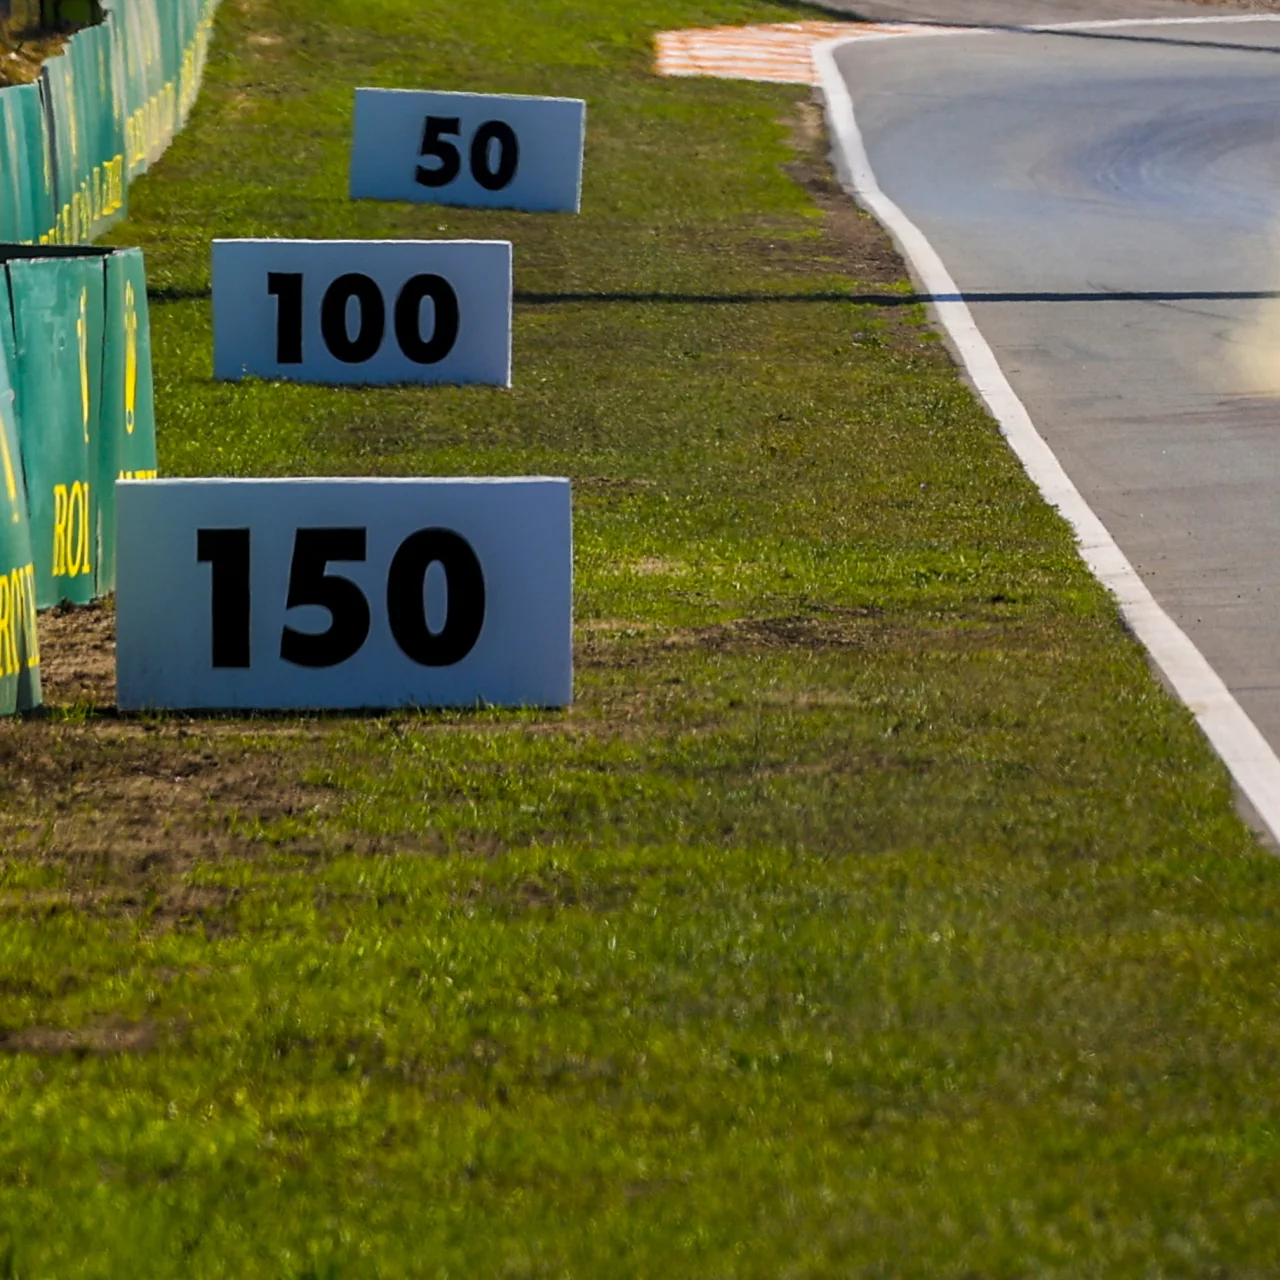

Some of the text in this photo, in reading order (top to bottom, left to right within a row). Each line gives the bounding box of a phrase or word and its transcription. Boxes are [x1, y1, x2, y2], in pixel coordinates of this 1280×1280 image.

[413, 116, 519, 191] 50
[266, 271, 460, 365] 100
[196, 526, 486, 669] 150
